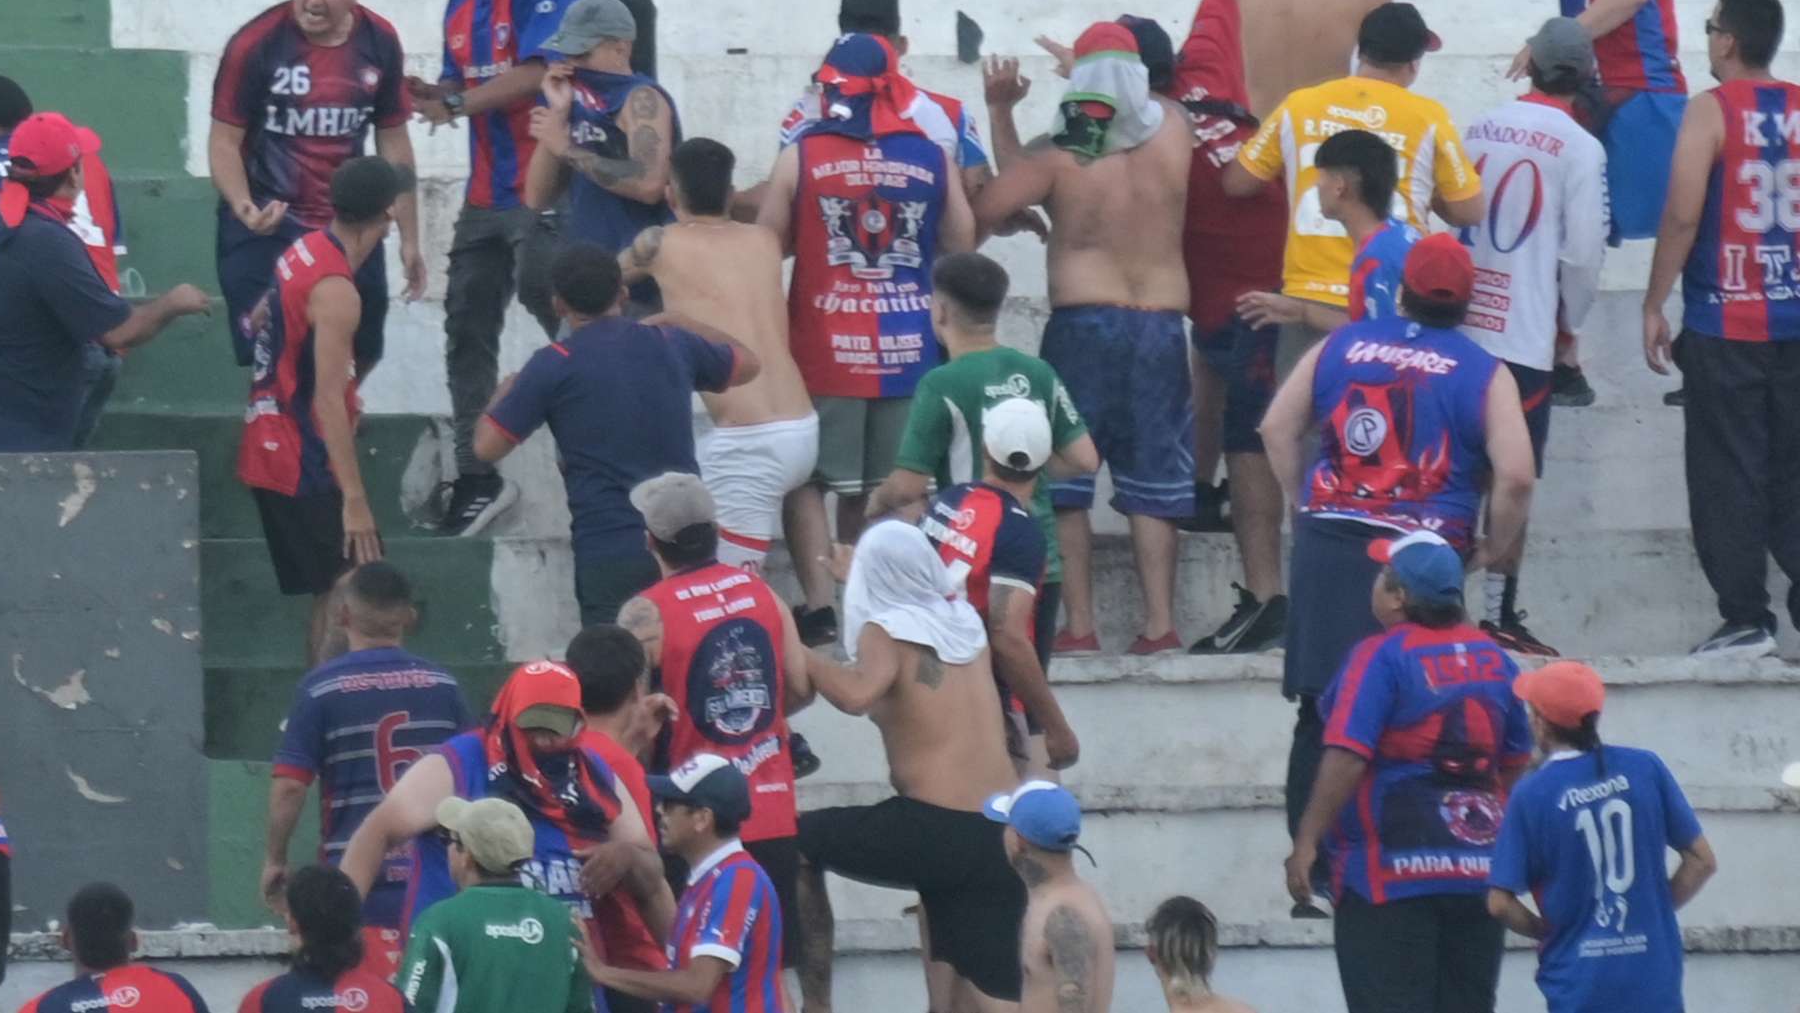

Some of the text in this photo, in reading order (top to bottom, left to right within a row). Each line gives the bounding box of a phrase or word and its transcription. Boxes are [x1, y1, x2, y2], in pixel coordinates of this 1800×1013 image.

[271, 65, 312, 95] 26
[1525, 131, 1566, 159] SUR
[1568, 774, 1631, 807] Rexona
[1575, 798, 1636, 895] 10
[1392, 855, 1456, 876] PARA
